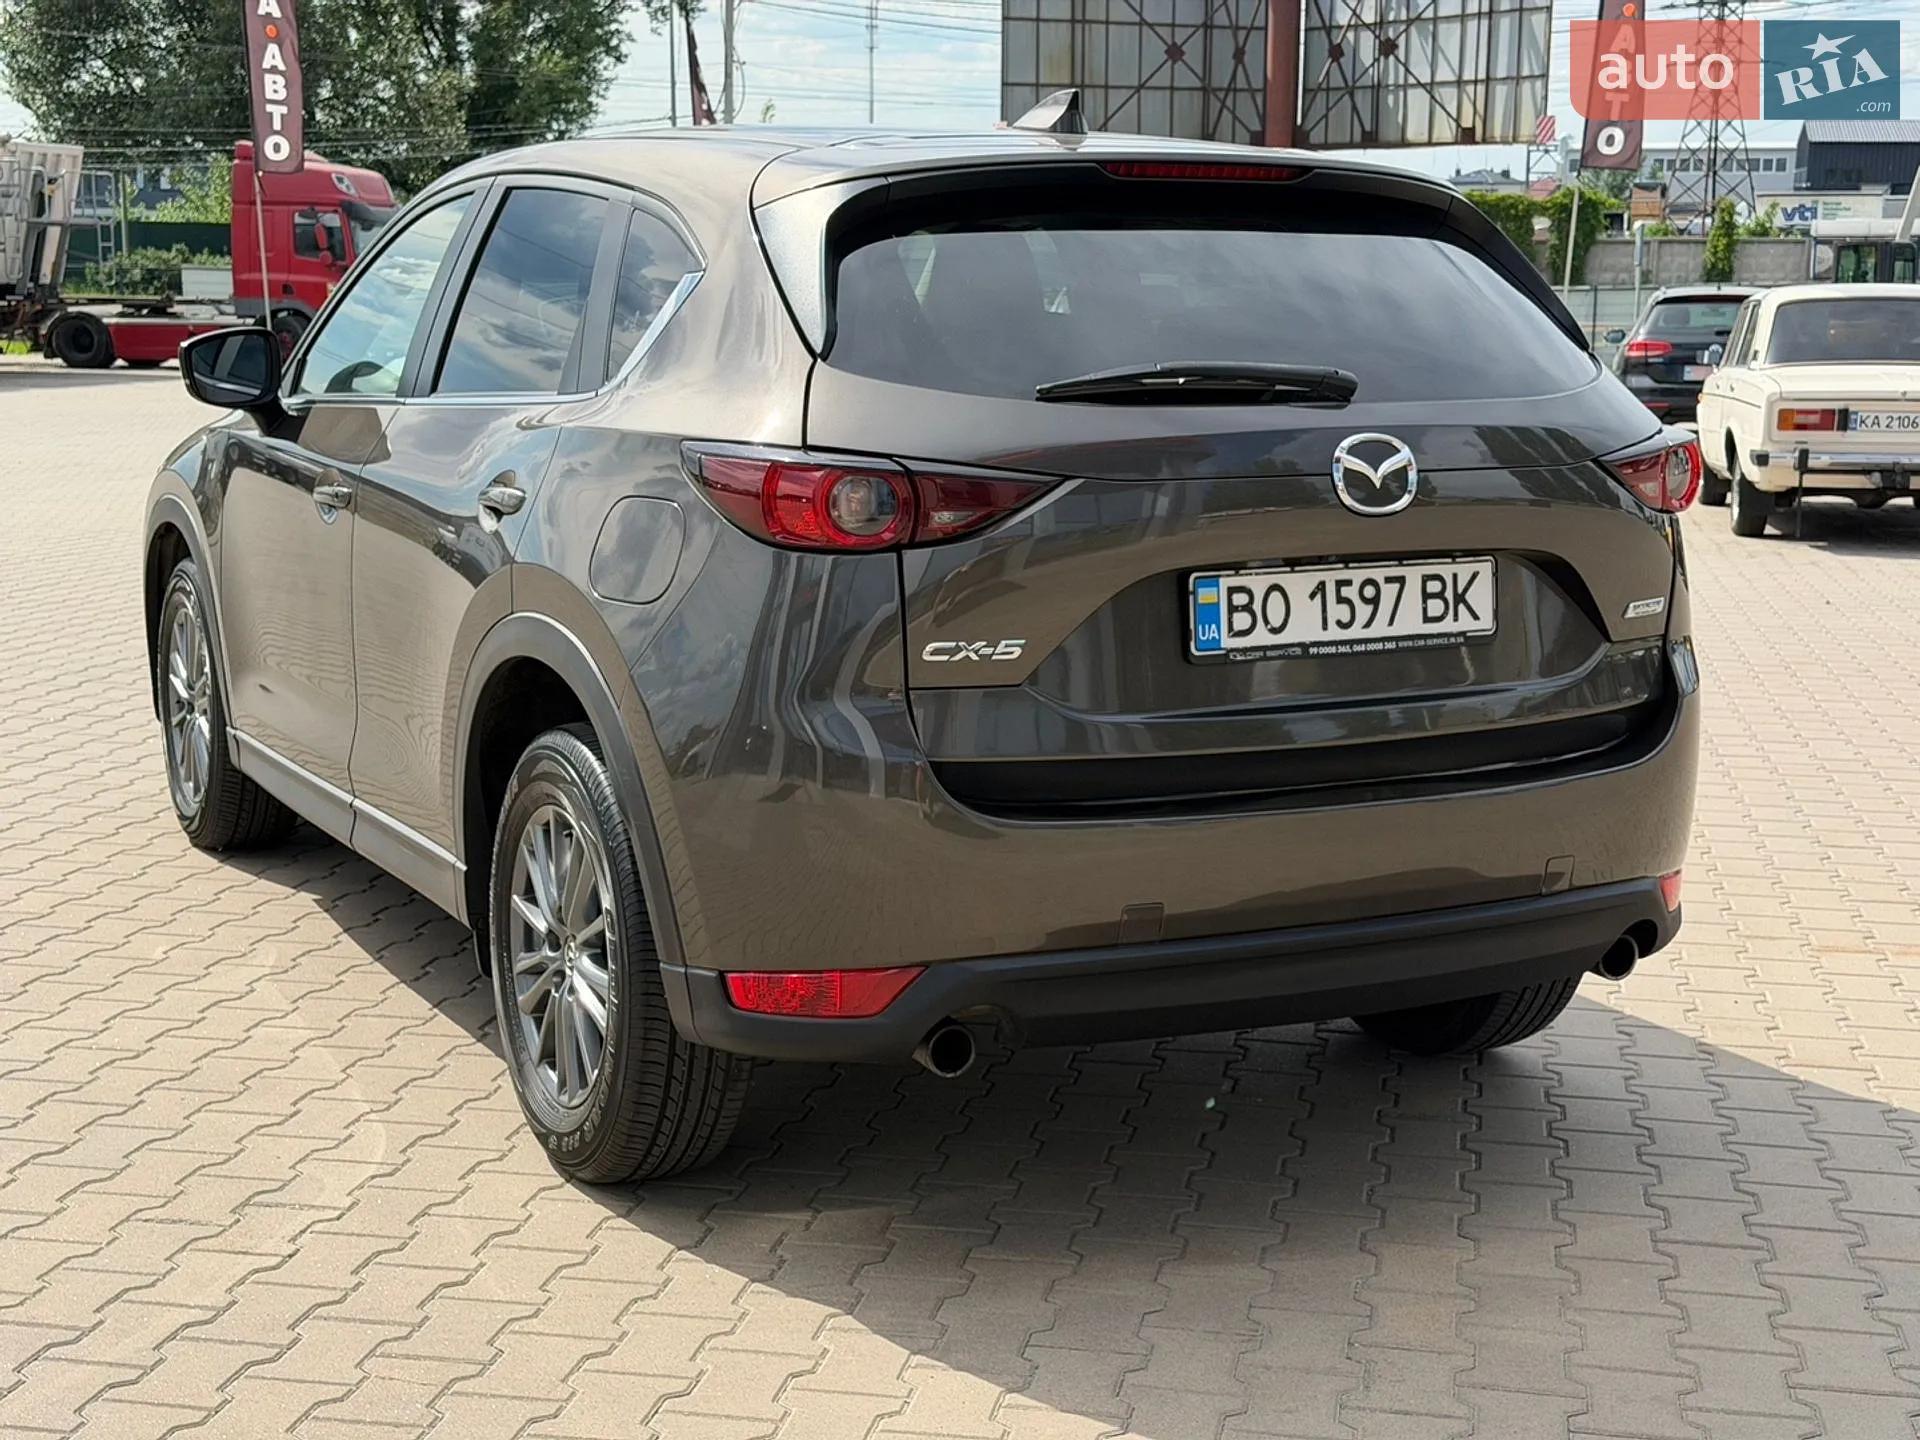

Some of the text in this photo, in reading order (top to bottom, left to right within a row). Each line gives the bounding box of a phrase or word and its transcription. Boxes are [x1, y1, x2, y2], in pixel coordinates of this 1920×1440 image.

[262, 43, 290, 161] АВТО
[1859, 414, 1880, 429] KA
[1885, 414, 1919, 429] 2106
[1227, 570, 1480, 638] BO 1597 BK
[1199, 623, 1219, 640] UA
[922, 640, 1026, 661] CX-5
